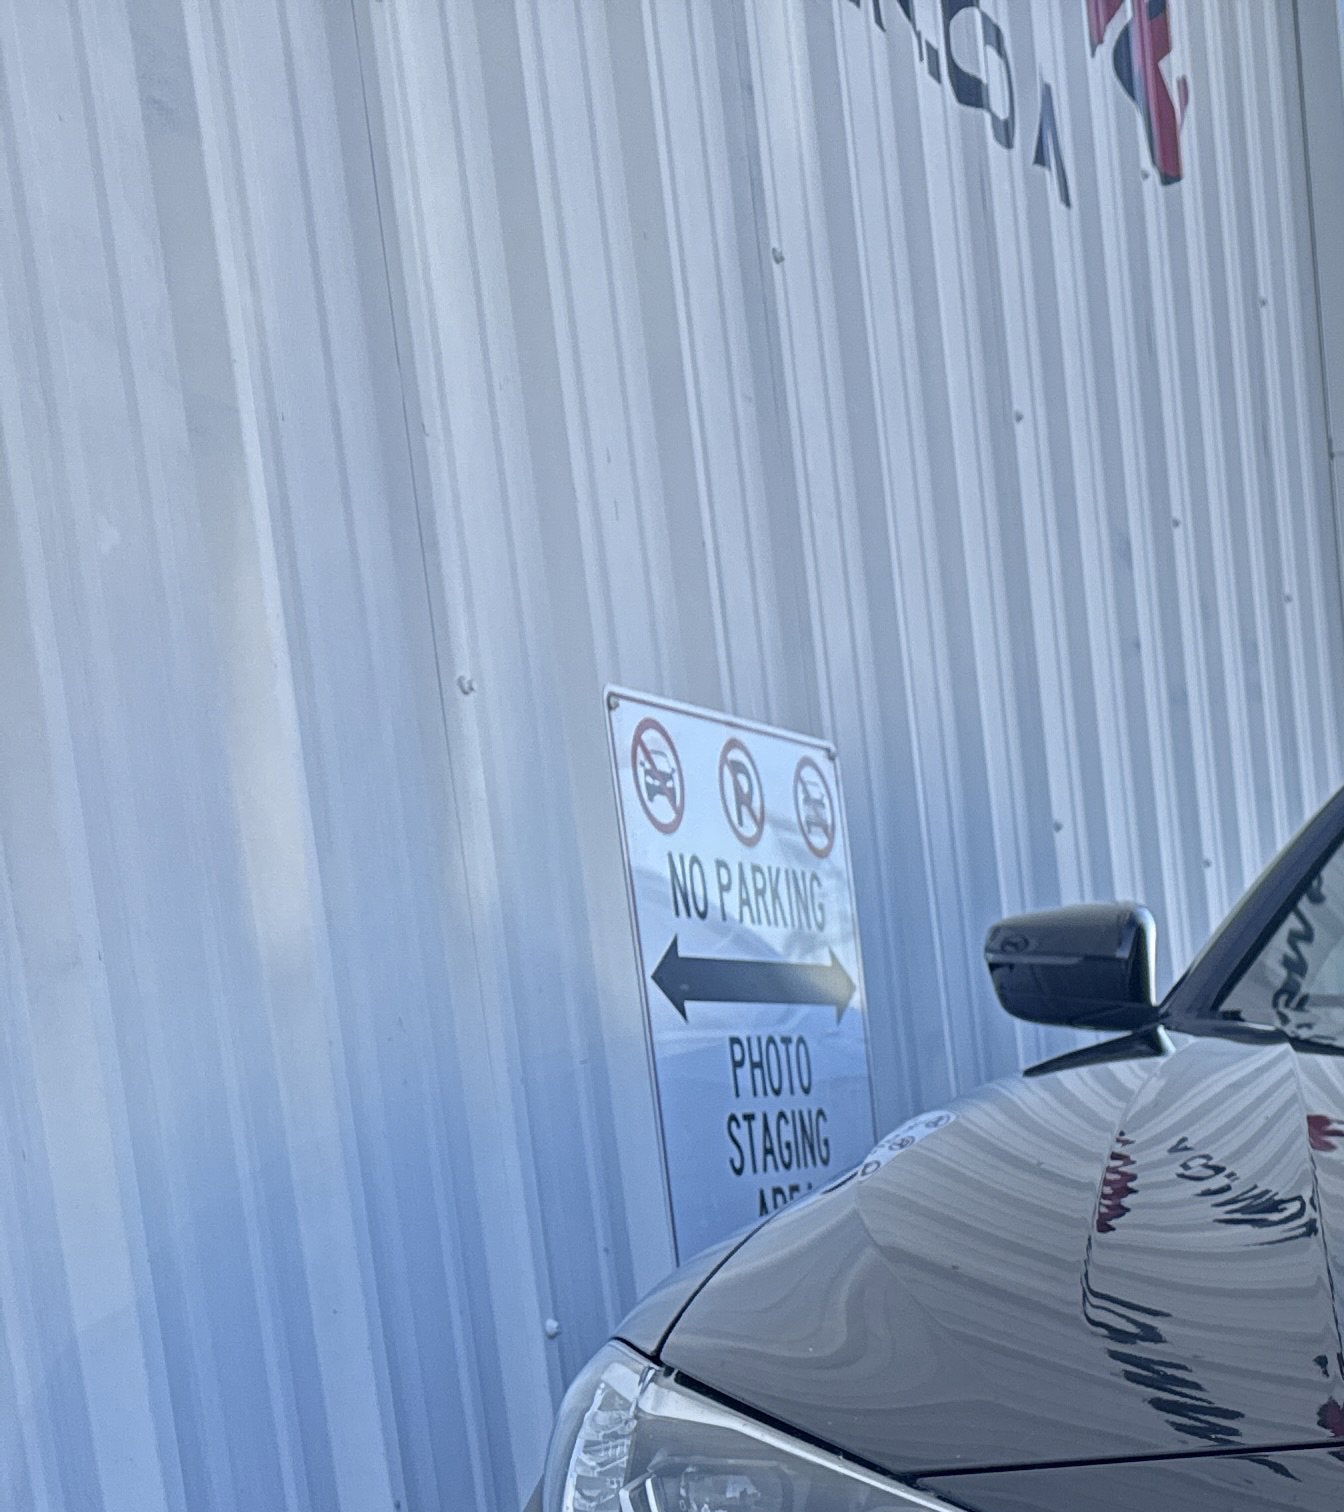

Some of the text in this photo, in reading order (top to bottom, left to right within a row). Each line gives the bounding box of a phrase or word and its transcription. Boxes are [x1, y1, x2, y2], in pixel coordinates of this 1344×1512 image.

[667, 851, 825, 932] NO PARKING
[729, 1035, 812, 1098] PHOTO
[727, 1107, 830, 1176] STAGING
